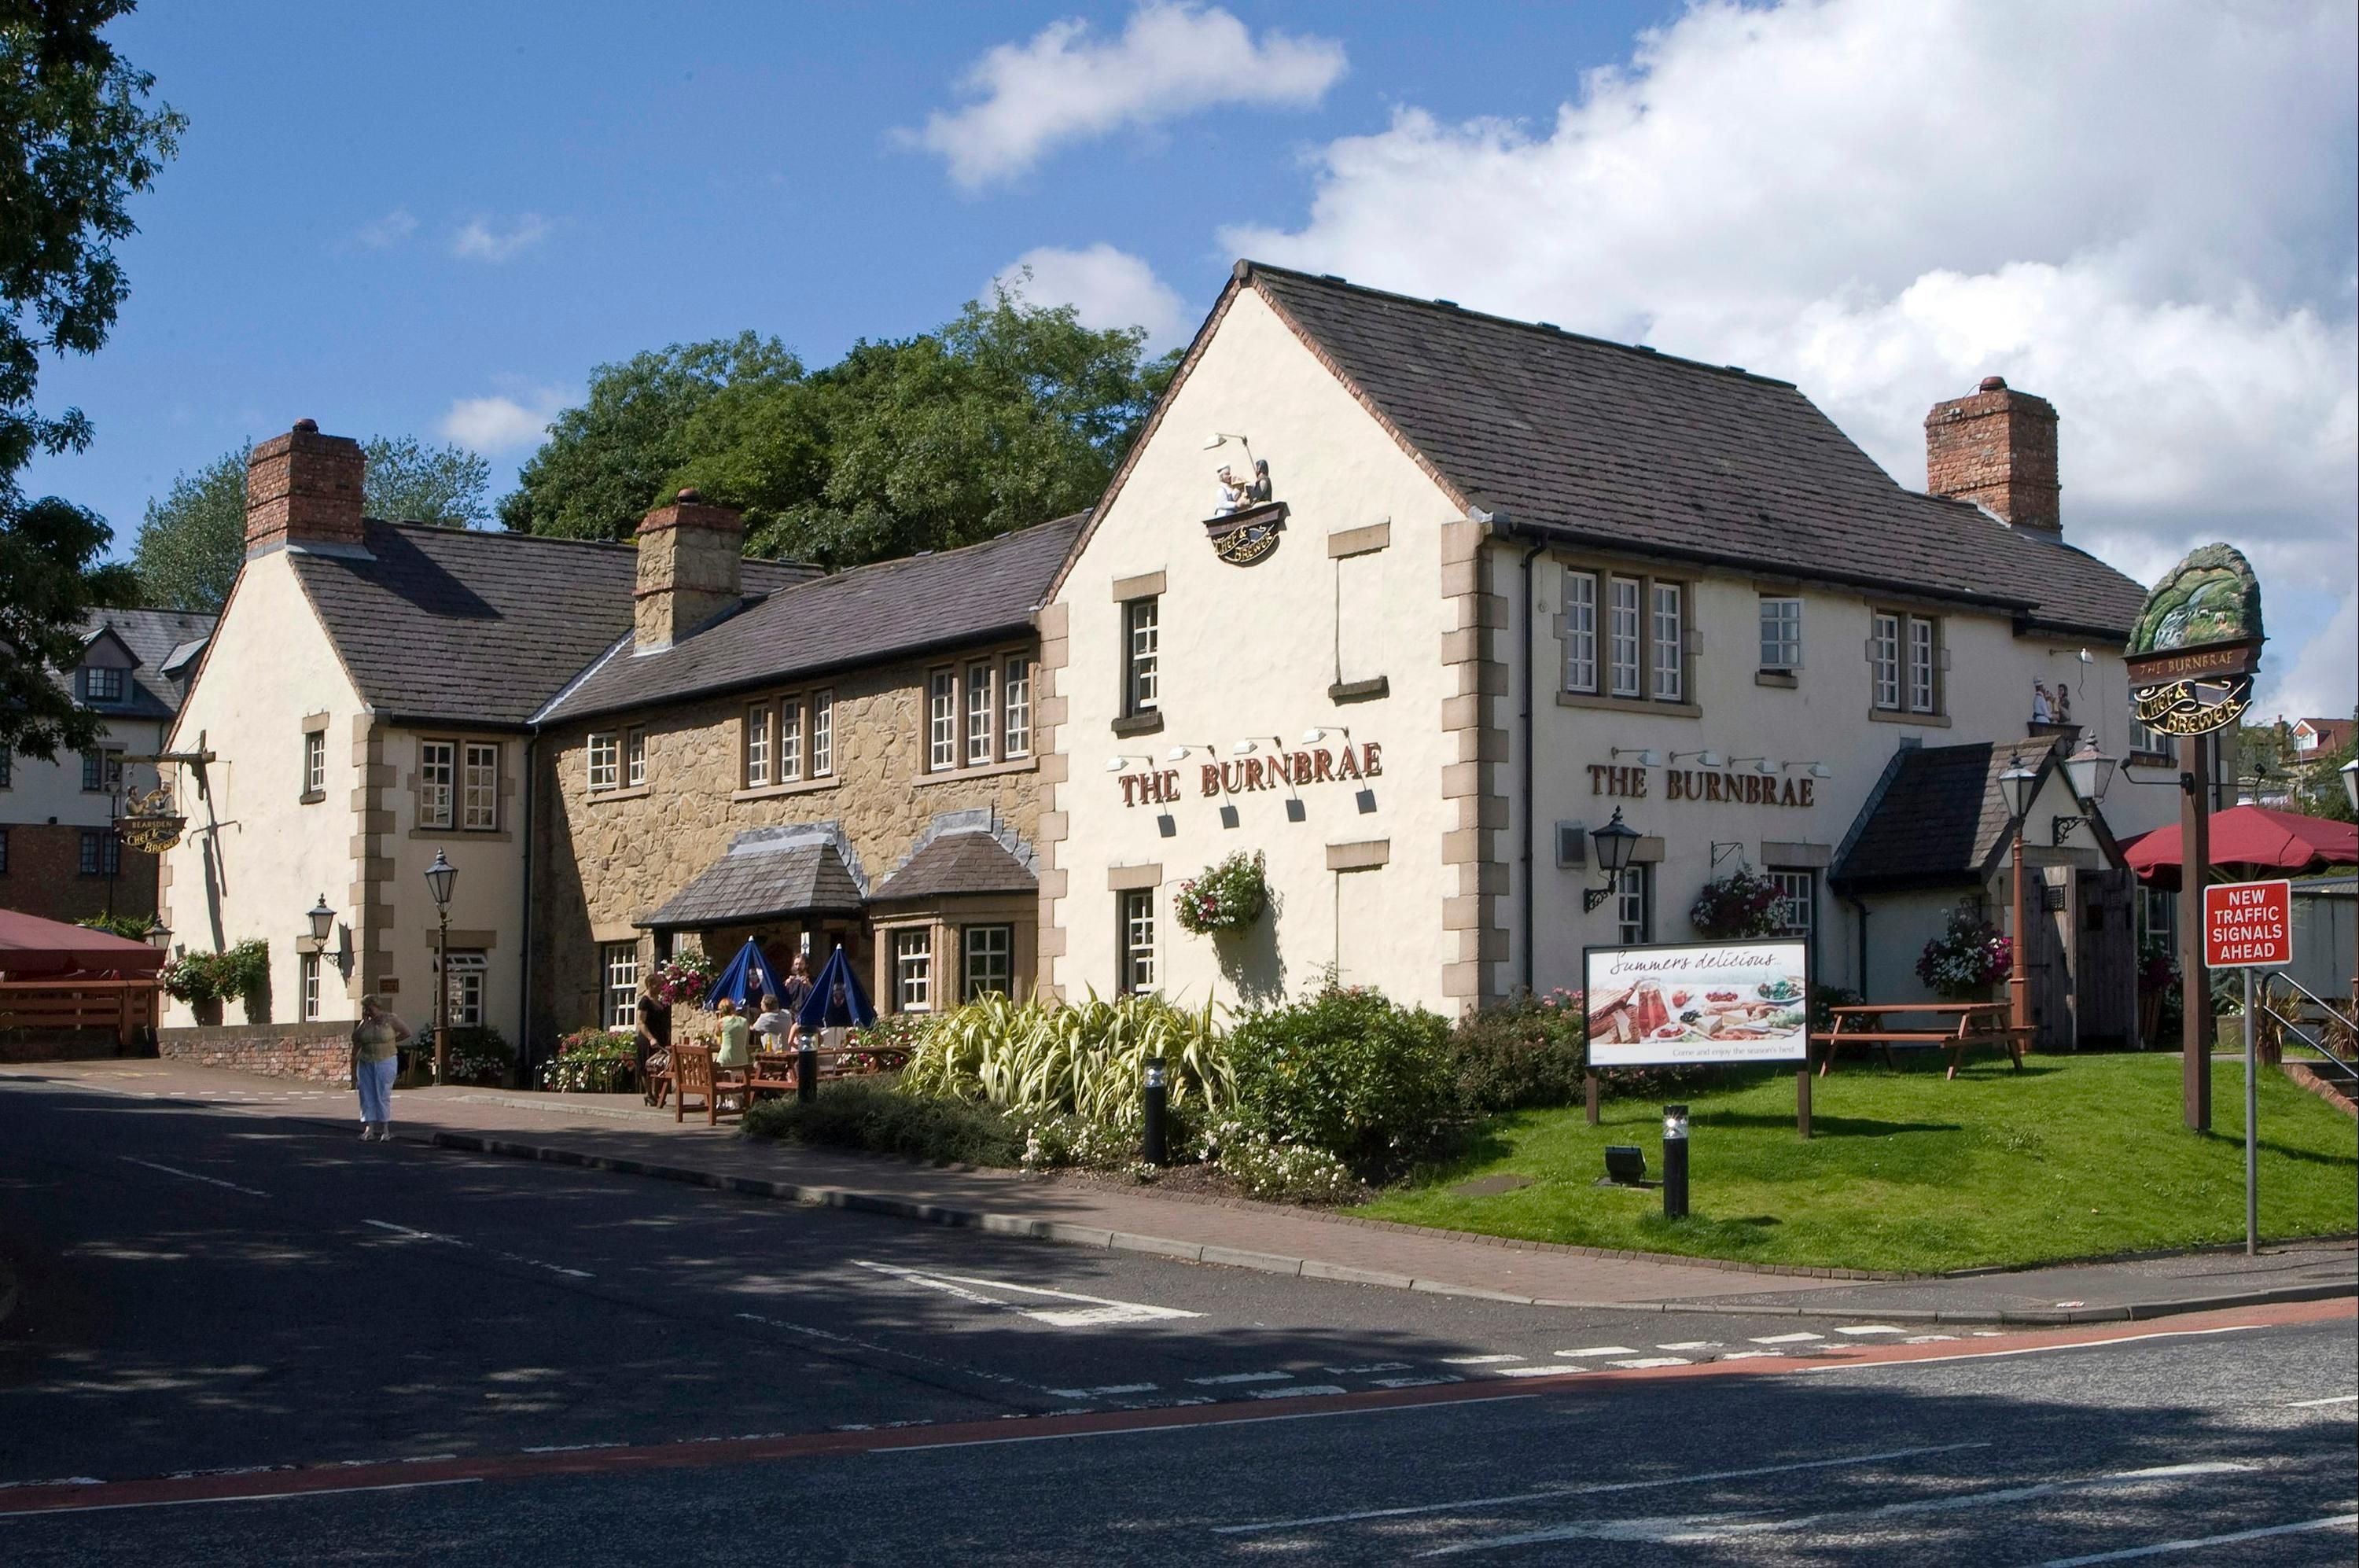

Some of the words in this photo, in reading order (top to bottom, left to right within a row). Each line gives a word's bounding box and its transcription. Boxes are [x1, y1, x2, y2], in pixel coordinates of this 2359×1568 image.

[1215, 535, 1236, 555] CHEF
[1239, 526, 1247, 539] &
[1235, 532, 1273, 561] BREWER
[2140, 663, 2162, 675] THE
[2139, 690, 2173, 720] CHEF
[2175, 683, 2188, 699] &
[2166, 699, 2241, 733] BREWER
[1119, 770, 1180, 807] THE
[1200, 742, 1382, 797] BURNBRAE
[1587, 764, 1647, 797] THE
[1666, 770, 1815, 807] BURNBRAE
[127, 832, 149, 845] CHEF
[2228, 889, 2265, 906] NEW
[2214, 906, 2280, 924] TRAFFIC
[2213, 923, 2283, 943] SIGNALS
[1610, 950, 1691, 974] Summer's
[2221, 942, 2275, 960] AHEAD
[1673, 1048, 1695, 1057] Come
[1712, 1047, 1731, 1057] enjoy
[1733, 1047, 1746, 1055] the
